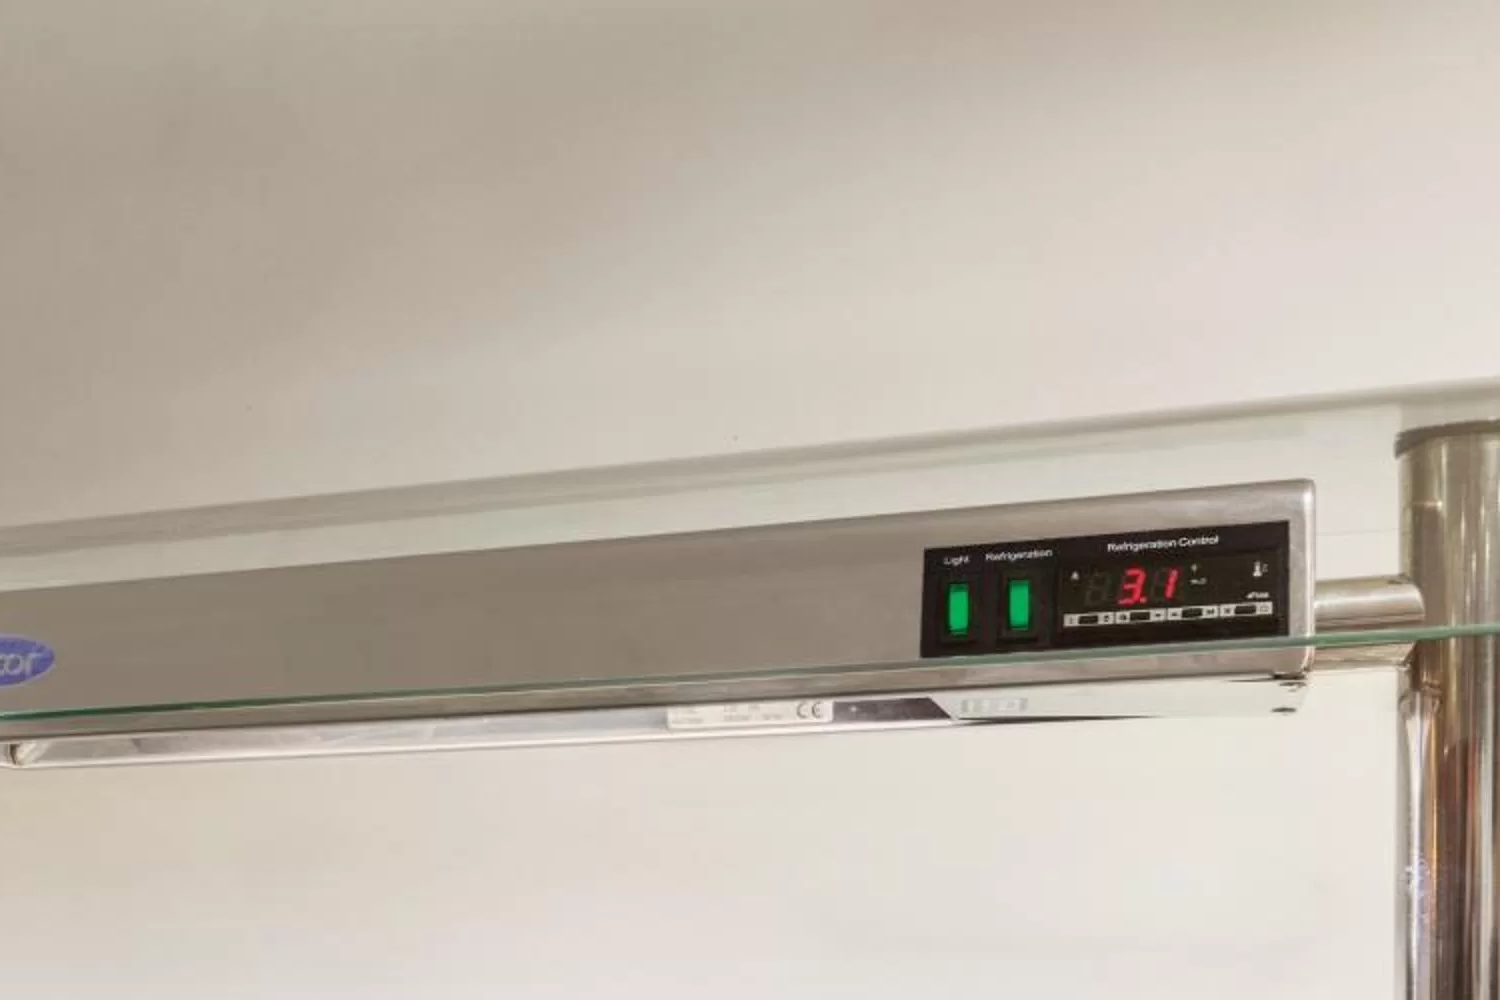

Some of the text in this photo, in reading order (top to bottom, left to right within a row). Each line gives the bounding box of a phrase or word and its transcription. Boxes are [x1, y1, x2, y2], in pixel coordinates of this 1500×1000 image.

[1107, 535, 1219, 553] Refrigeration Control
[944, 556, 970, 567] Light
[985, 549, 1053, 562] Refrigeration
